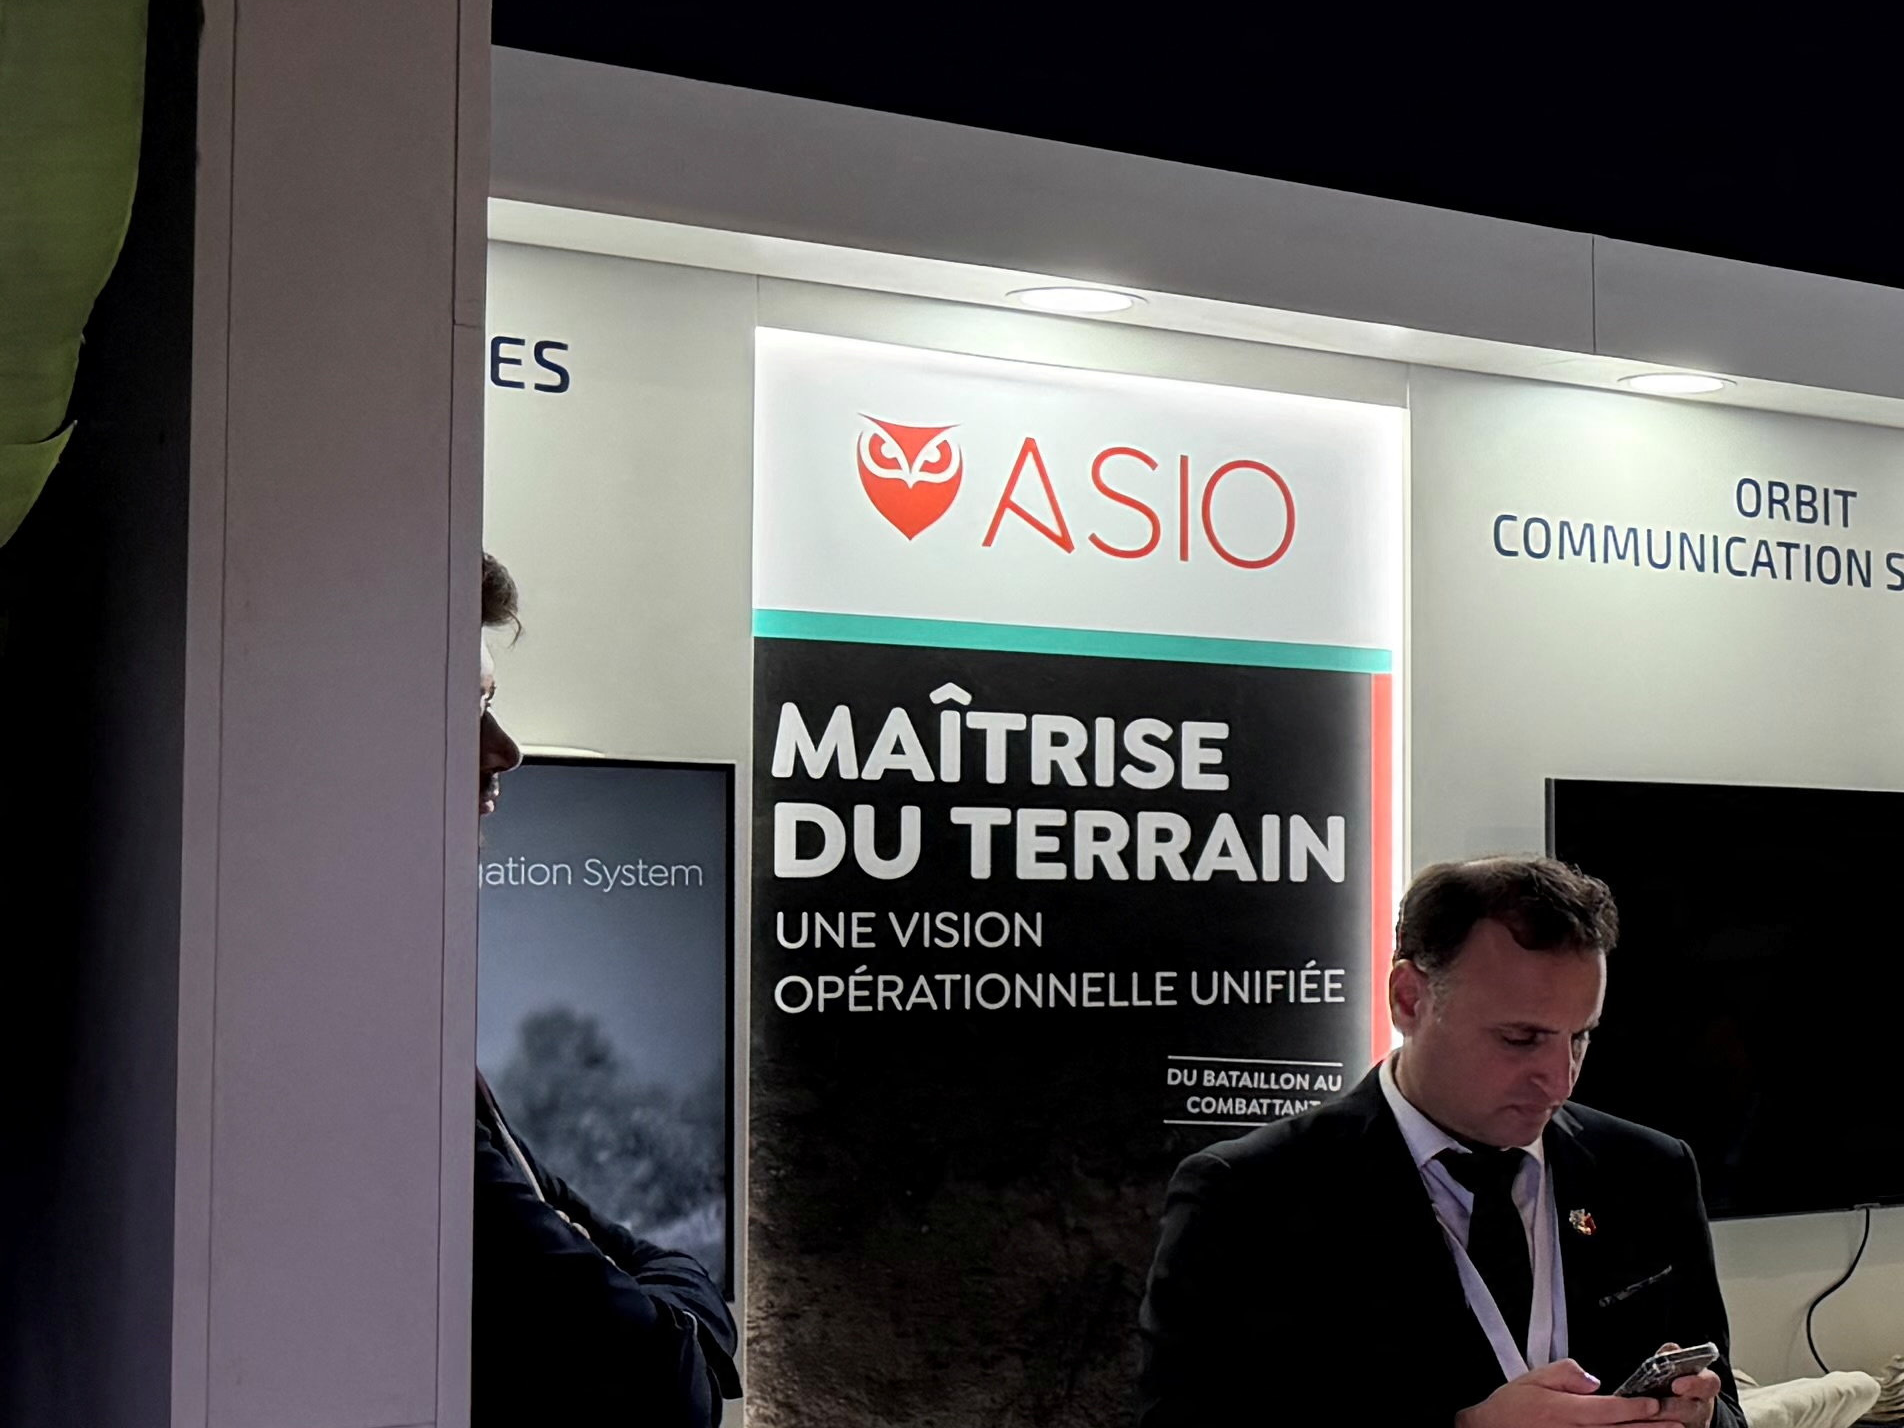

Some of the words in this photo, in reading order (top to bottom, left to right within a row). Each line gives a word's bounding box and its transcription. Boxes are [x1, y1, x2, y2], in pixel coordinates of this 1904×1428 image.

[982, 437, 1295, 569] ASIO
[1736, 476, 1858, 528] ORBIT
[1492, 514, 1873, 589] COMMUNICATION
[772, 682, 1230, 791] MAÎTRISE
[773, 802, 922, 881] DU
[949, 808, 1347, 884] TERRAIN
[583, 858, 703, 893] System
[776, 910, 876, 951] UNE
[887, 910, 1044, 948] VISION
[776, 963, 1178, 1014] OPÉRATIONNELLE
[1190, 959, 1347, 1007] UNIFIÉE
[1167, 1068, 1197, 1086] DU
[1203, 1069, 1309, 1091] BATAILLON
[1313, 1073, 1342, 1092] AU
